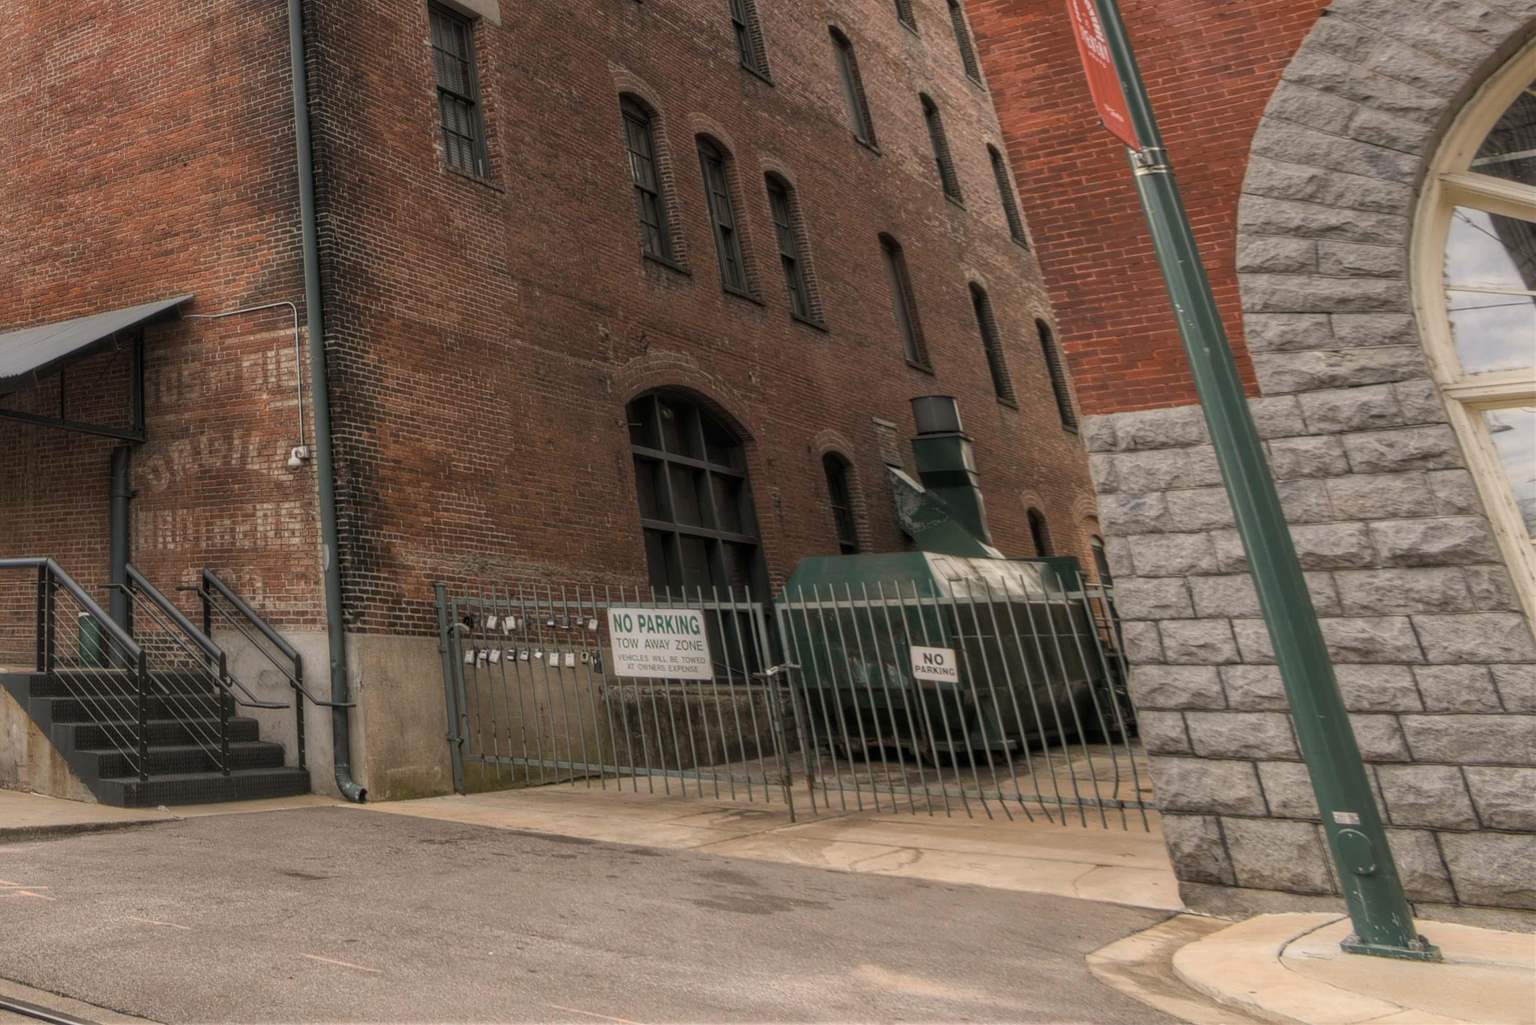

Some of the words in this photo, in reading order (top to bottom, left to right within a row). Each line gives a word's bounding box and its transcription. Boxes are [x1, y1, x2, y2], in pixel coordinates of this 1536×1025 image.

[613, 613, 633, 633] NO
[638, 614, 701, 635] PARKING
[616, 637, 639, 649] TOW
[645, 639, 671, 650] AWAY
[676, 639, 704, 651] ZONE
[618, 654, 649, 663] VEHICLES
[652, 655, 666, 663] WILL
[681, 656, 706, 665] TOWED
[923, 652, 944, 666] NO
[638, 663, 666, 672] OWNERS
[668, 665, 698, 673] EXPENSE
[915, 665, 955, 676] PARKING
